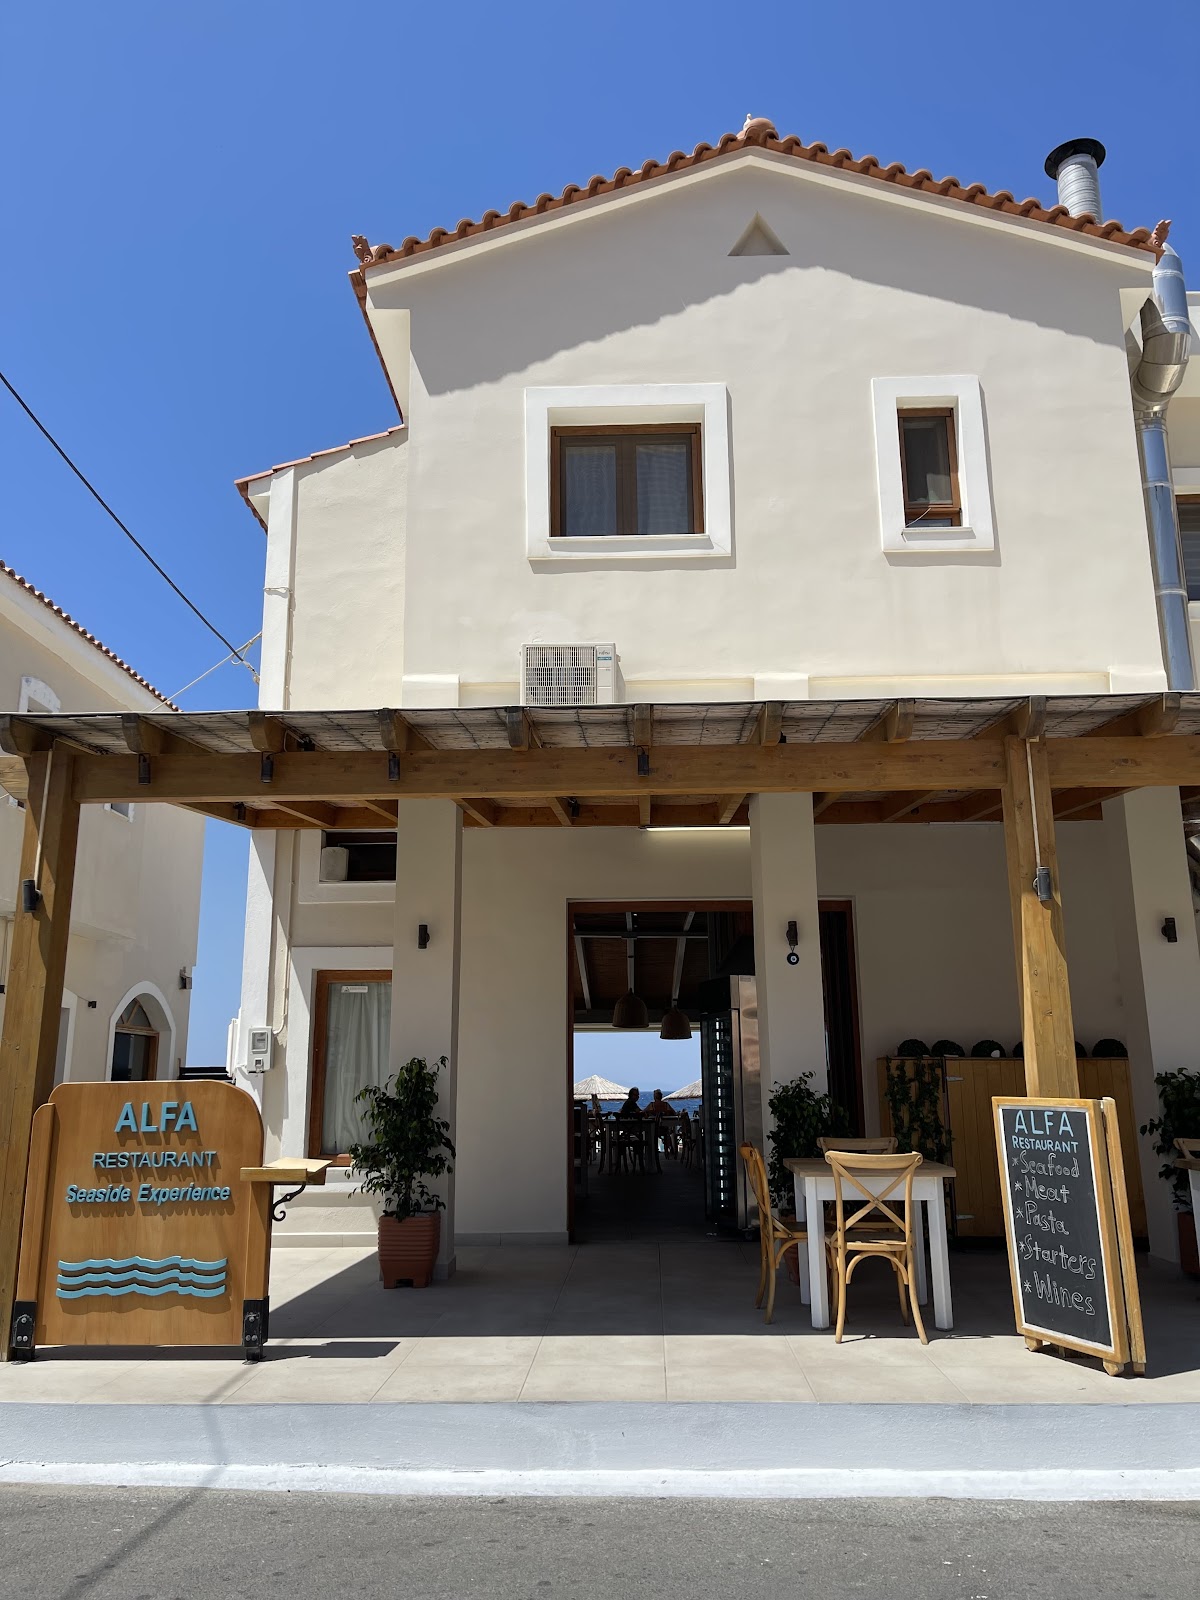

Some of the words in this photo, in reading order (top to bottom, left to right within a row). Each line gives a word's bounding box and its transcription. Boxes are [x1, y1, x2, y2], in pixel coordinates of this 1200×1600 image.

[114, 1101, 198, 1132] ALFA
[1015, 1110, 1074, 1137] ALFA
[1012, 1135, 1078, 1153] RESTAURANT
[92, 1151, 217, 1168] RESTAURANT
[1020, 1150, 1080, 1178] Seafood
[65, 1184, 131, 1204] Seaside
[137, 1183, 231, 1206] Experience
[1024, 1175, 1070, 1203] Meat
[1024, 1200, 1070, 1236] Pasta
[1023, 1233, 1097, 1280] Starters
[1033, 1270, 1096, 1316] Wines
